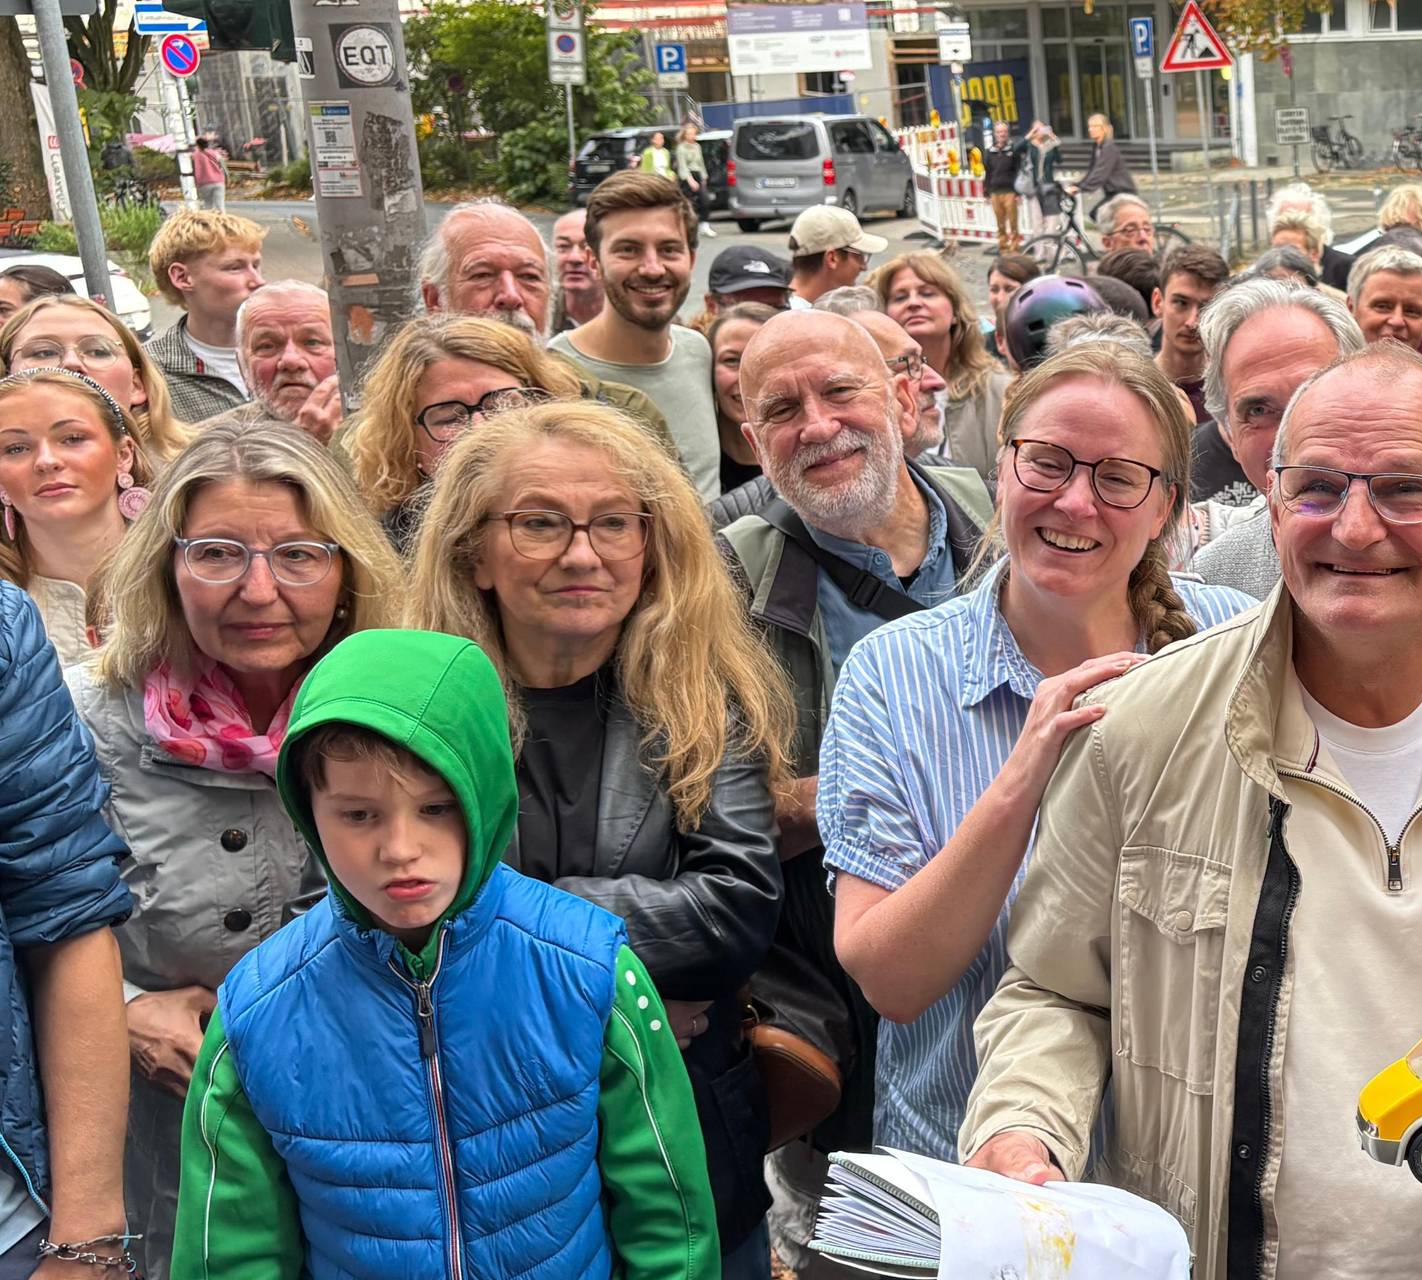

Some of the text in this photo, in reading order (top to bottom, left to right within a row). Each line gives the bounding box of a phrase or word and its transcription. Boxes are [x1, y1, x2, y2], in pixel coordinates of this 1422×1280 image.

[1135, 23, 1148, 54] P
[343, 45, 388, 66] EQT
[660, 47, 680, 70] P
